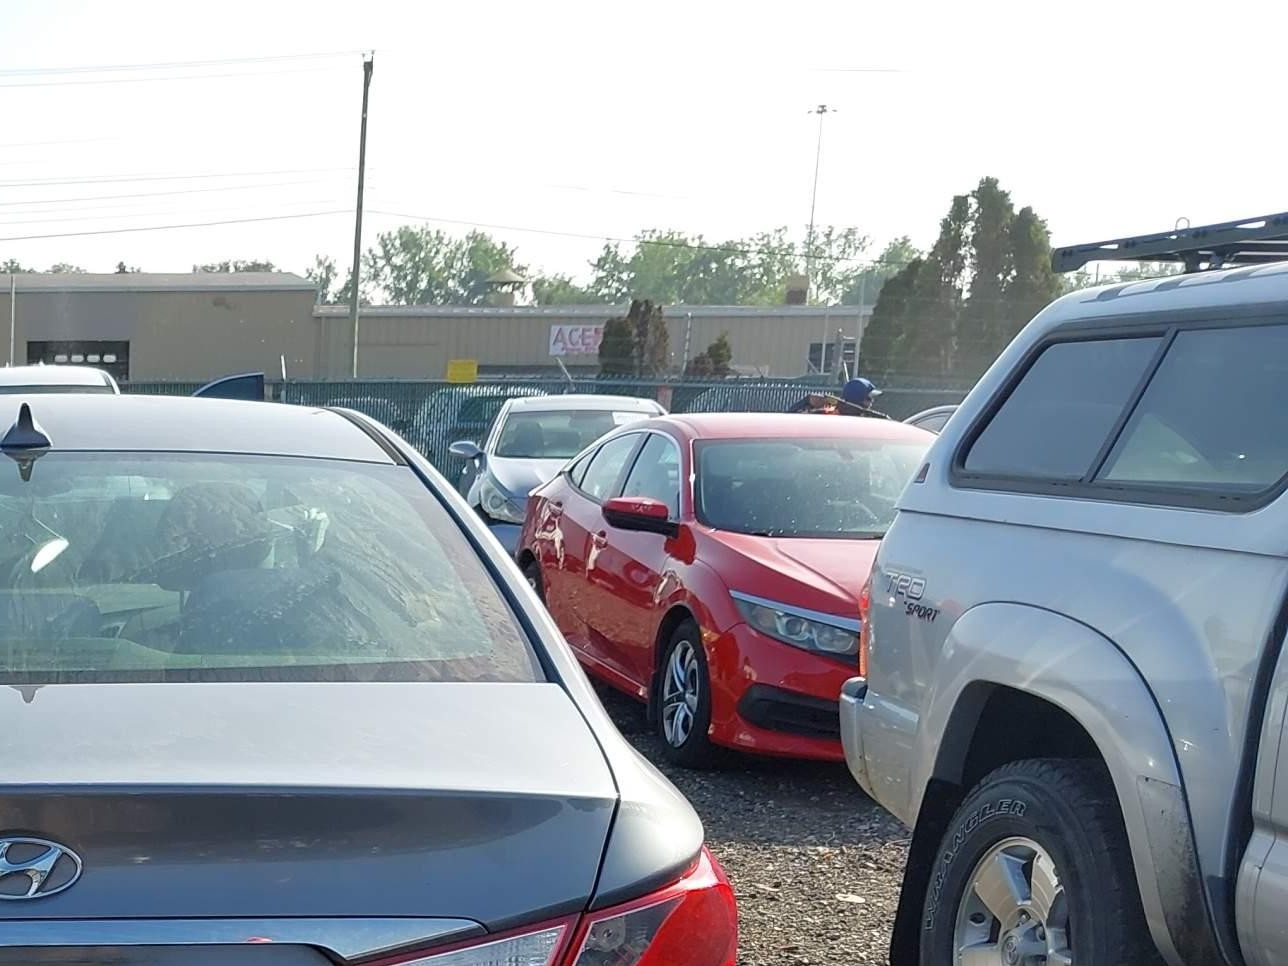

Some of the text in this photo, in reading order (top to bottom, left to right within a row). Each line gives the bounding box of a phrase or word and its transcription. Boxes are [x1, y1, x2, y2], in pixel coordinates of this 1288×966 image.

[886, 571, 927, 601] TRD
[903, 601, 940, 622] SPORT
[923, 799, 1027, 931] WRANGLER
